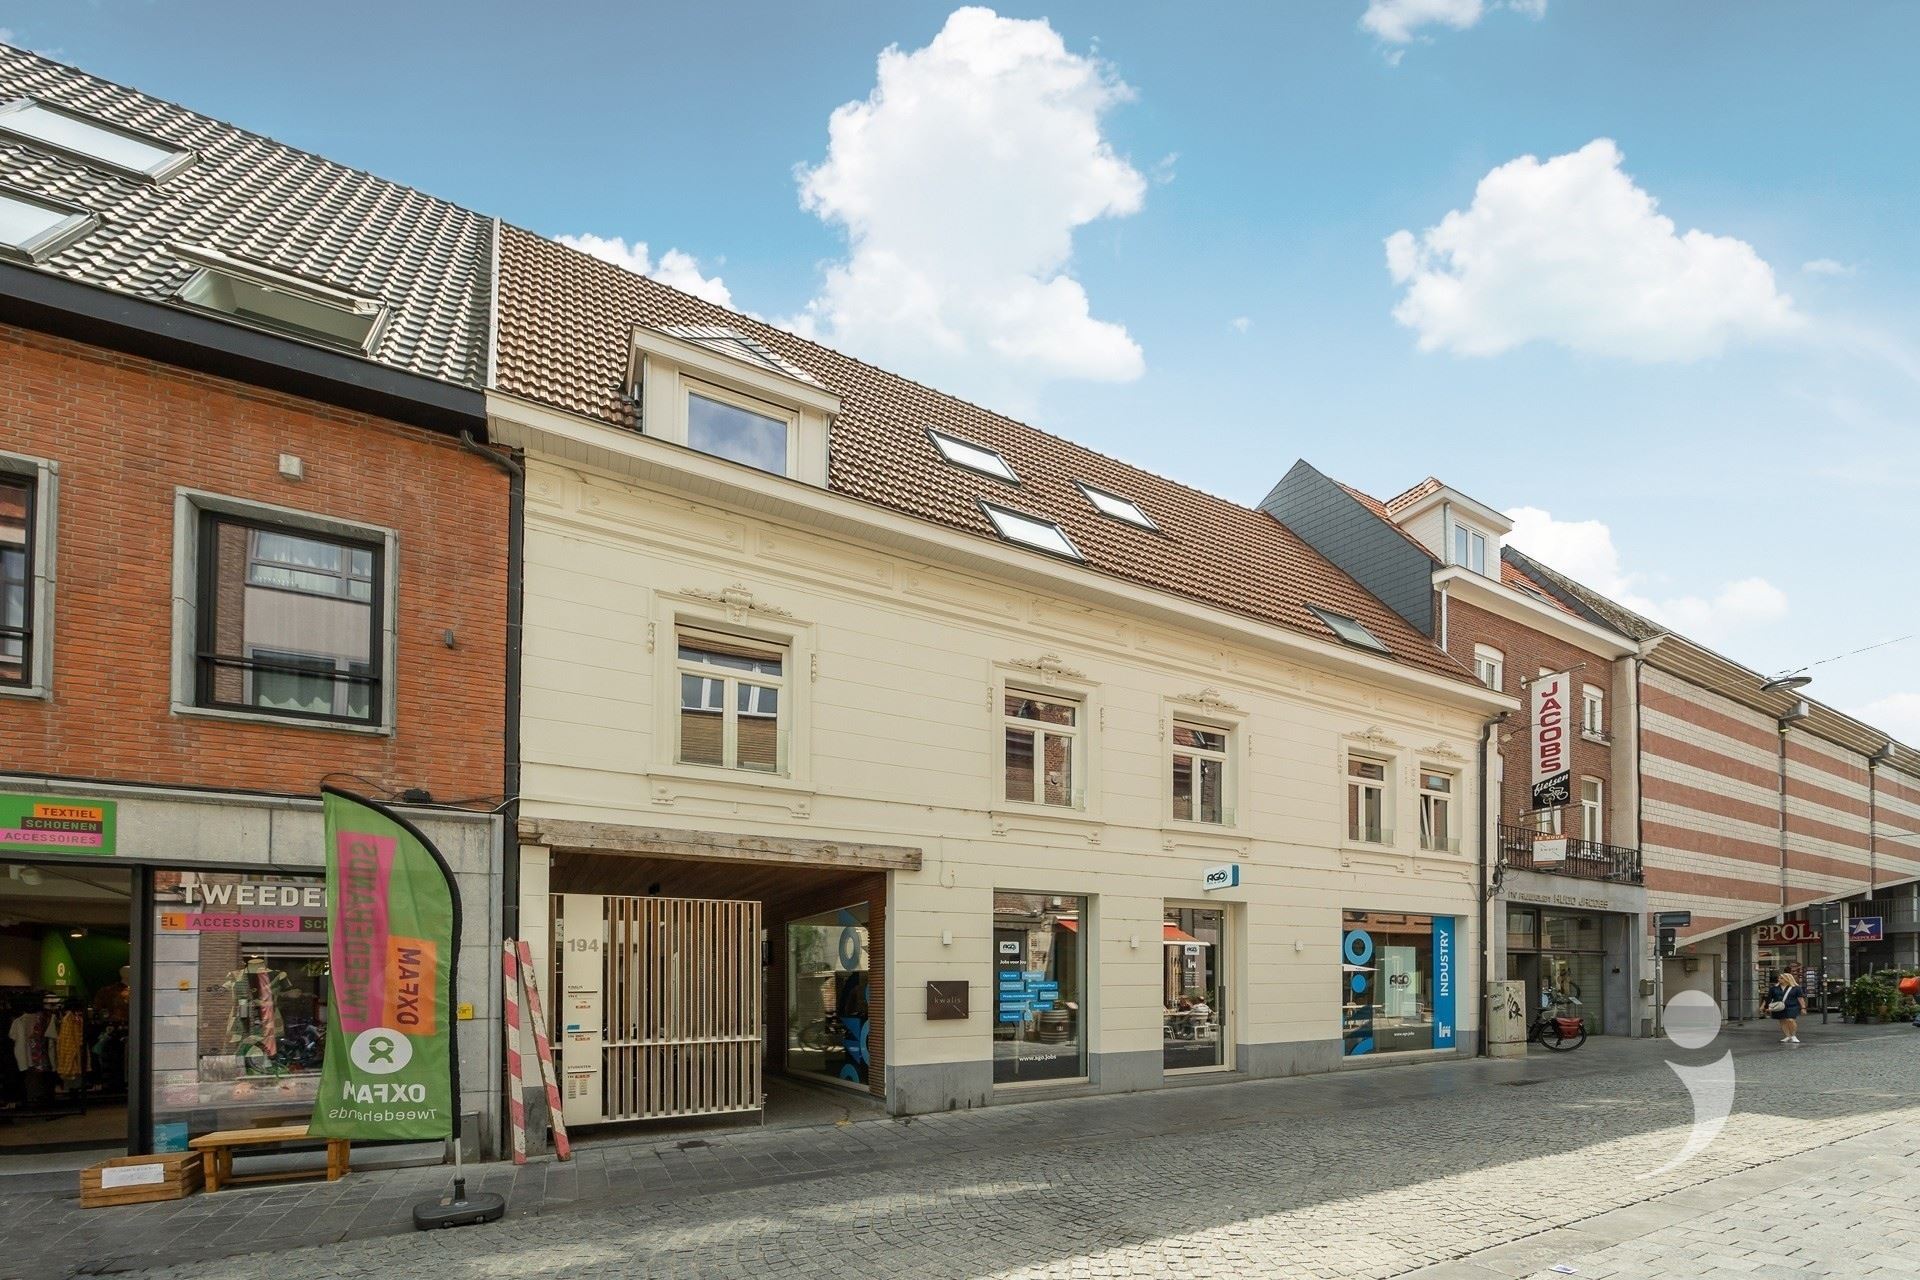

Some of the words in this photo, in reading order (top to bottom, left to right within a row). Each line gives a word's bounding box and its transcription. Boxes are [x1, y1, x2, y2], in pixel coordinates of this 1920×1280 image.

[1539, 682, 1561, 773] JACOBS
[1534, 774, 1569, 796] fietsen
[42, 807, 97, 819] TEXTIEL
[26, 819, 97, 831] SCHOENEN
[4, 832, 96, 844] ACCESSOIRES
[1207, 870, 1228, 883] AGO
[179, 883, 328, 907] TWEEDE
[193, 917, 295, 929] ACCESSOIRES
[567, 938, 599, 953] 194
[1440, 930, 1449, 996] INDUSTRY
